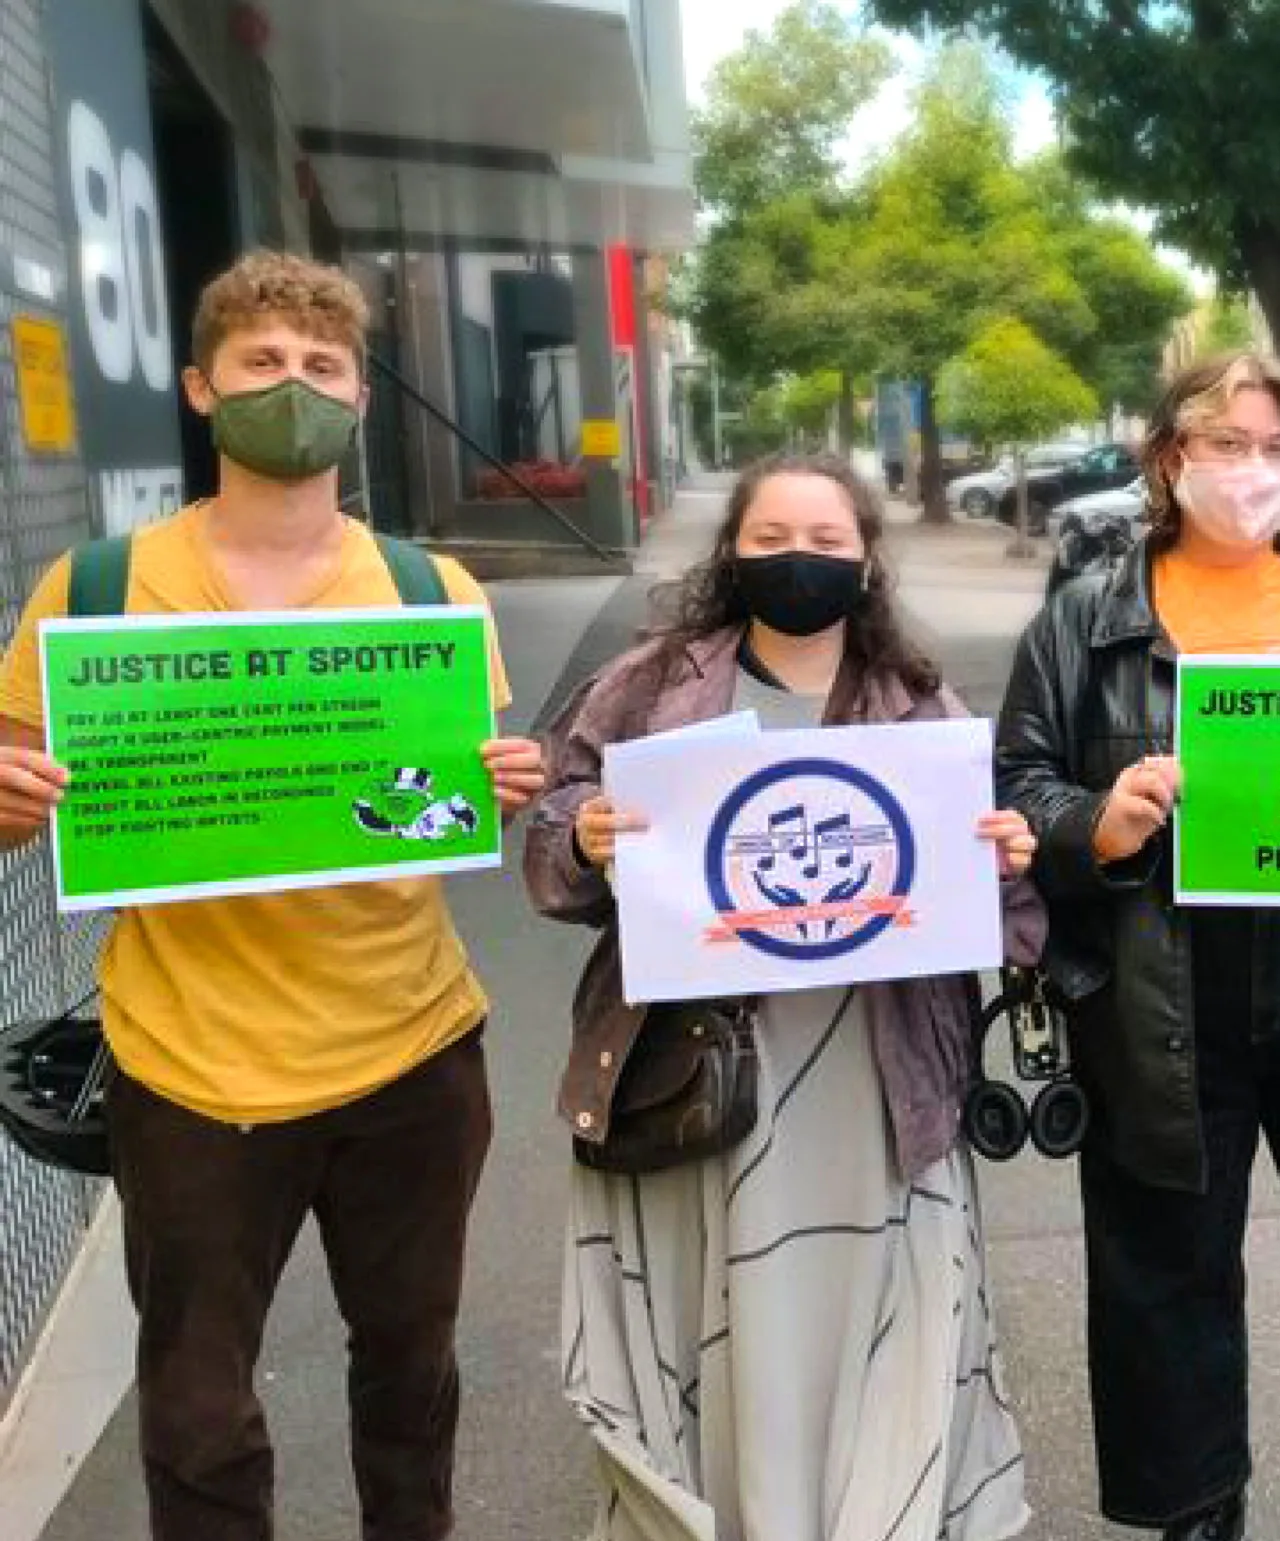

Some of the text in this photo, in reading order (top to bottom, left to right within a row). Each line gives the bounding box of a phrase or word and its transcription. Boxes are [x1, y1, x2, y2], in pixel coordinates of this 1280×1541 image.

[67, 98, 174, 392] 80
[68, 641, 456, 687] JUSTICE AT SPOTIFY
